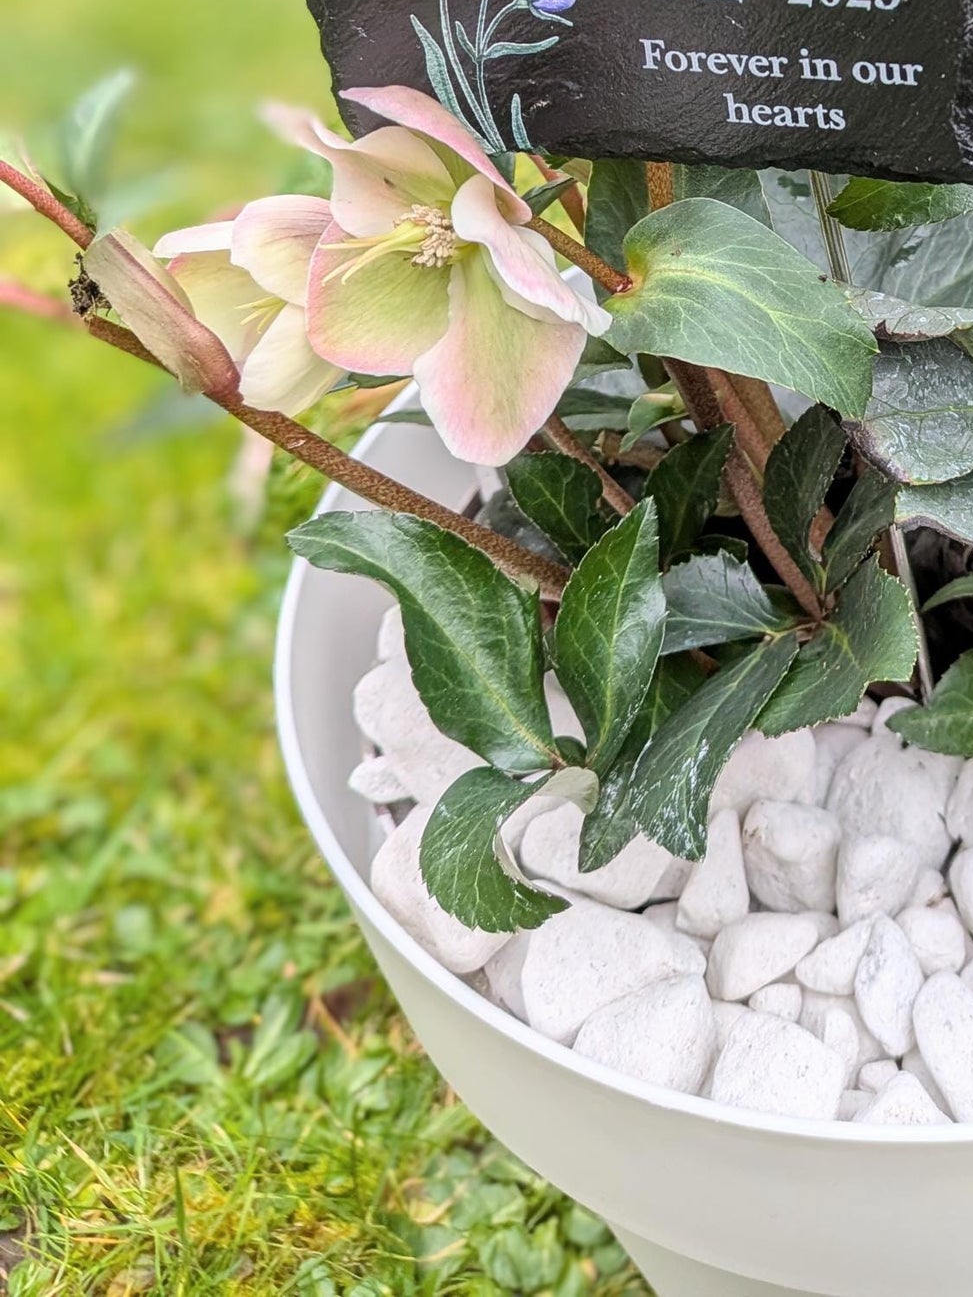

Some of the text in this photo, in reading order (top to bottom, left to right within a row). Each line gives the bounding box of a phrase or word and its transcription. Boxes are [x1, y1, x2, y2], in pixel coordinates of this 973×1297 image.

[640, 39, 923, 85] Forever in our
[723, 93, 845, 130] hearts
